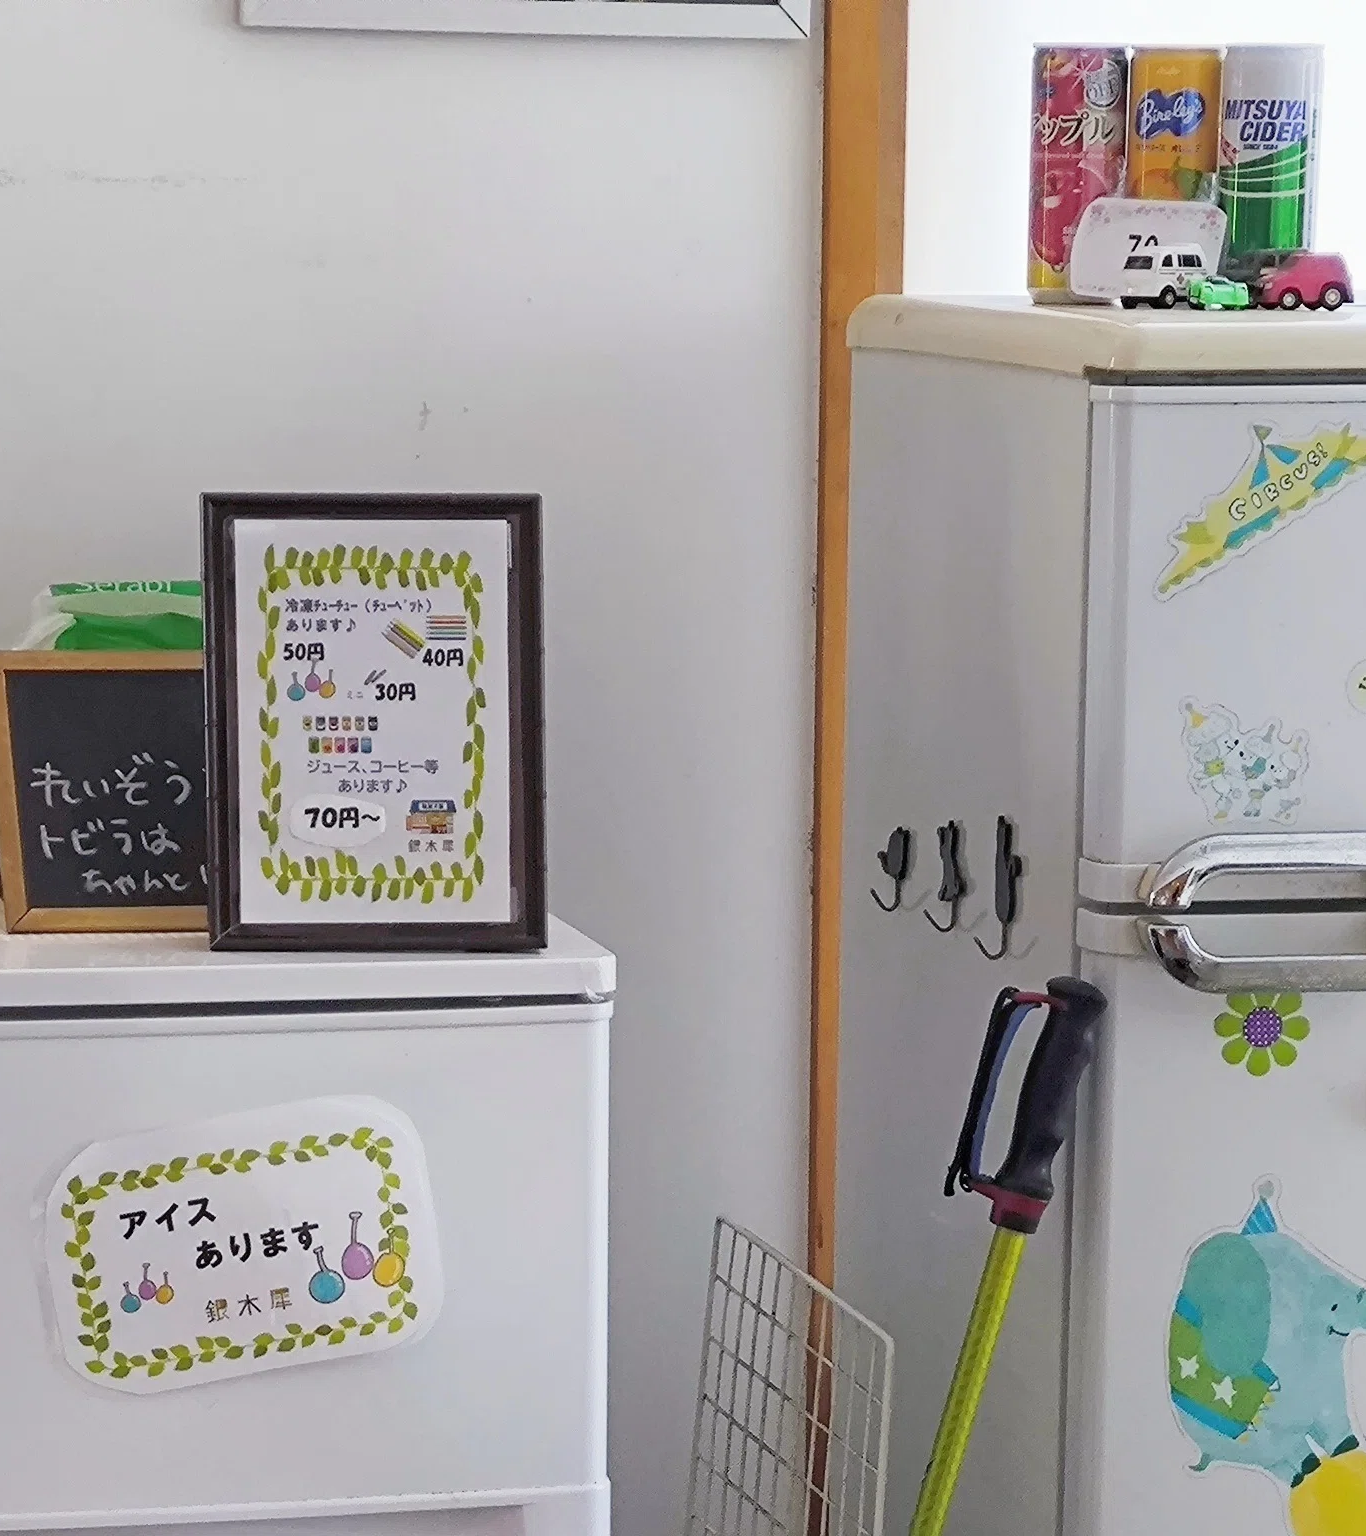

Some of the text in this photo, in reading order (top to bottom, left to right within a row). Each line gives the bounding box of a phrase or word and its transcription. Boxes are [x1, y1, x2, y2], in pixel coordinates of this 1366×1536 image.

[1225, 100, 1307, 120] MITSUYA
[1240, 121, 1305, 142] CIDER
[1228, 442, 1328, 520] CIRCUS!
[283, 642, 325, 661] 50円
[422, 647, 464, 667] 40円
[374, 682, 417, 702] 30円
[30, 752, 207, 807] れいぞう
[40, 817, 181, 860] トビラは
[119, 1197, 217, 1240] アイス
[195, 1222, 320, 1269] あります
